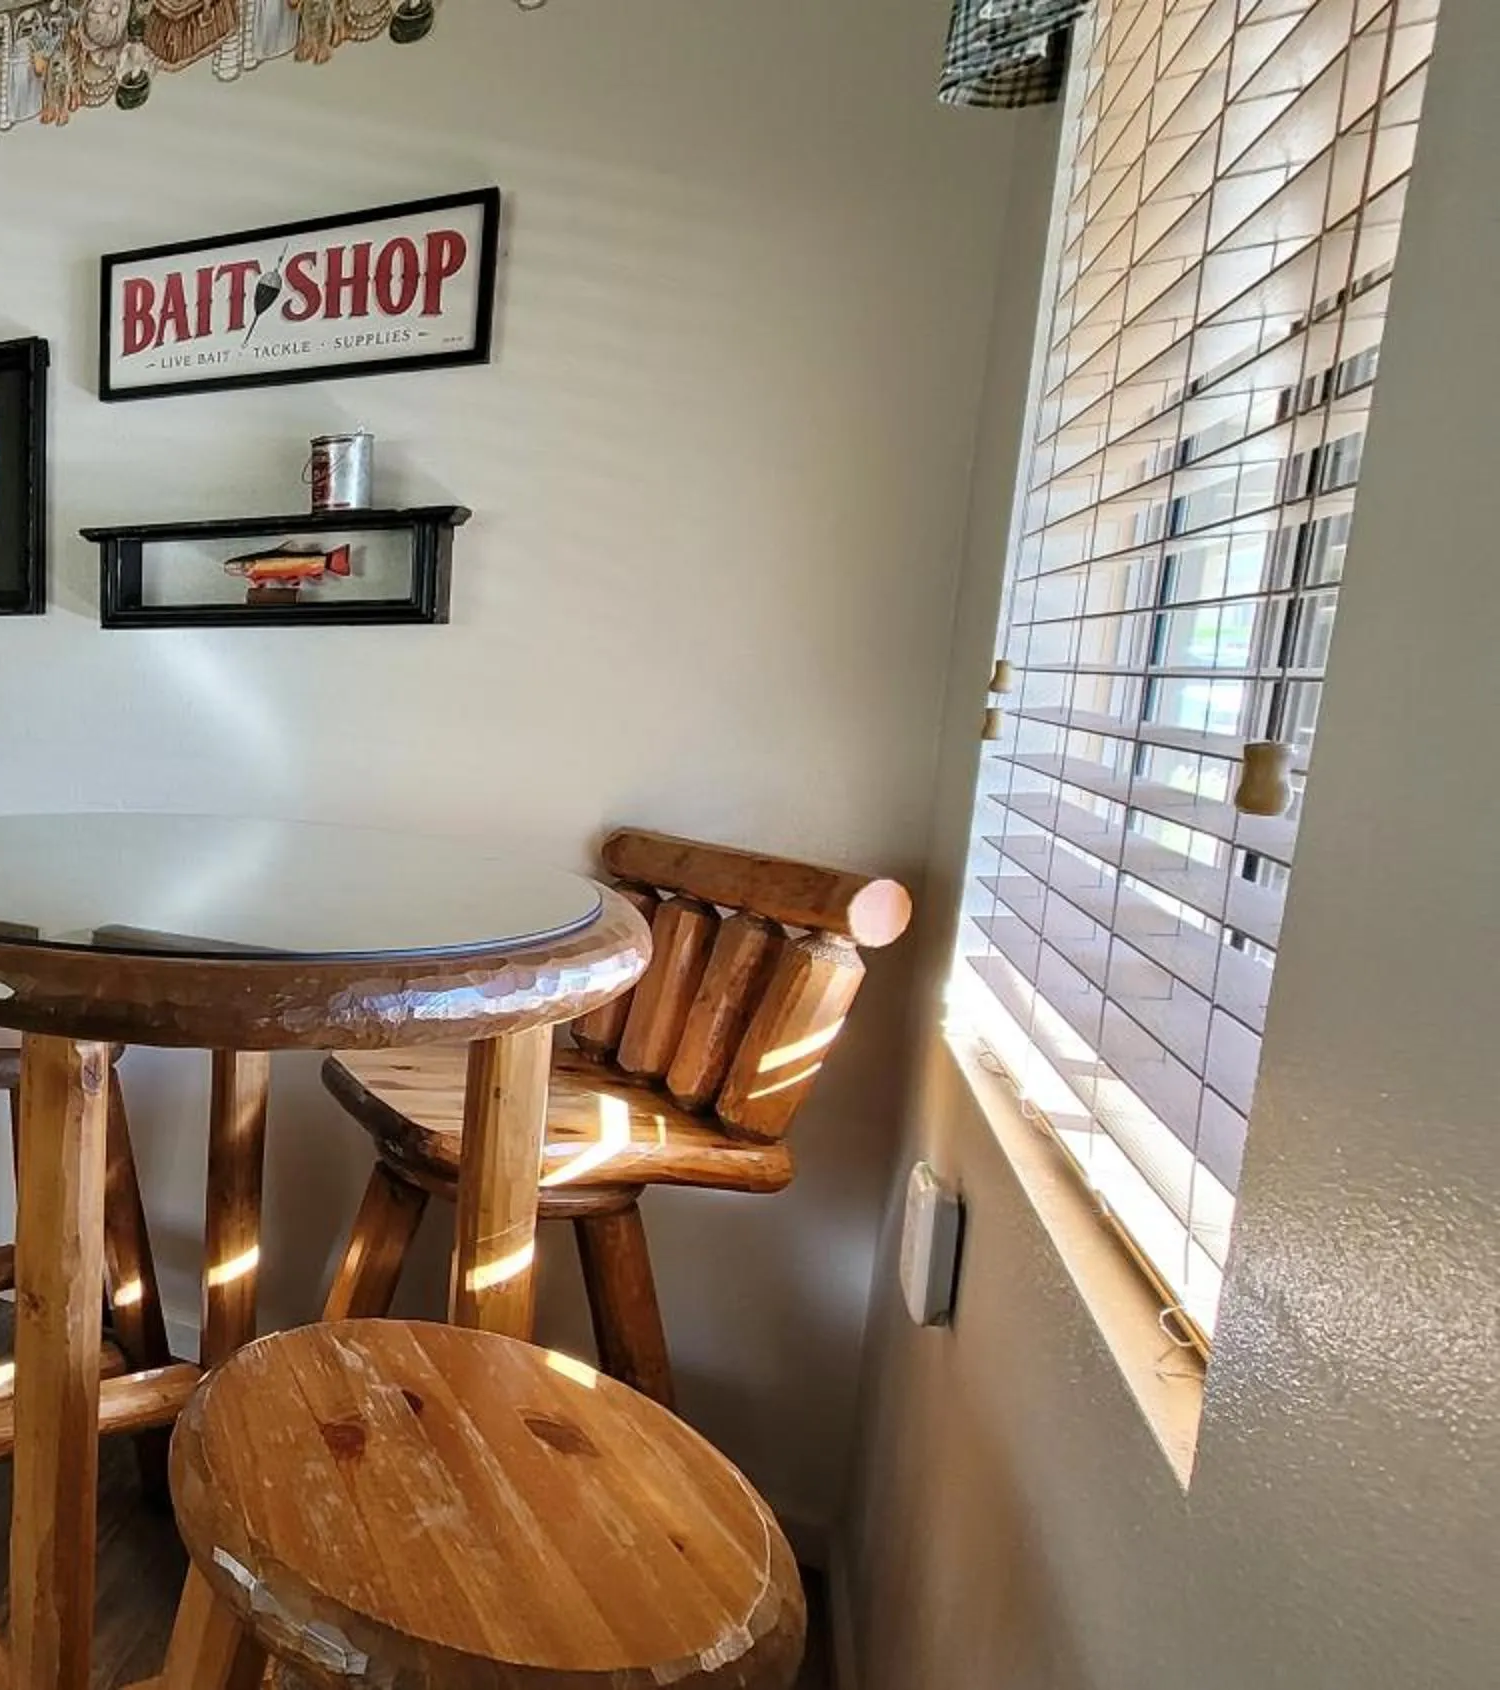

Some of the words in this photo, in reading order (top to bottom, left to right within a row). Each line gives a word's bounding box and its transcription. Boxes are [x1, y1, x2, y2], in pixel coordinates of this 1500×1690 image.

[122, 259, 262, 357] BAIT
[281, 229, 468, 322] SHOP
[160, 354, 192, 369] LIVE
[197, 351, 232, 366] BAIT
[253, 341, 312, 359] TACKLE
[333, 329, 412, 350] SUPPLIES
